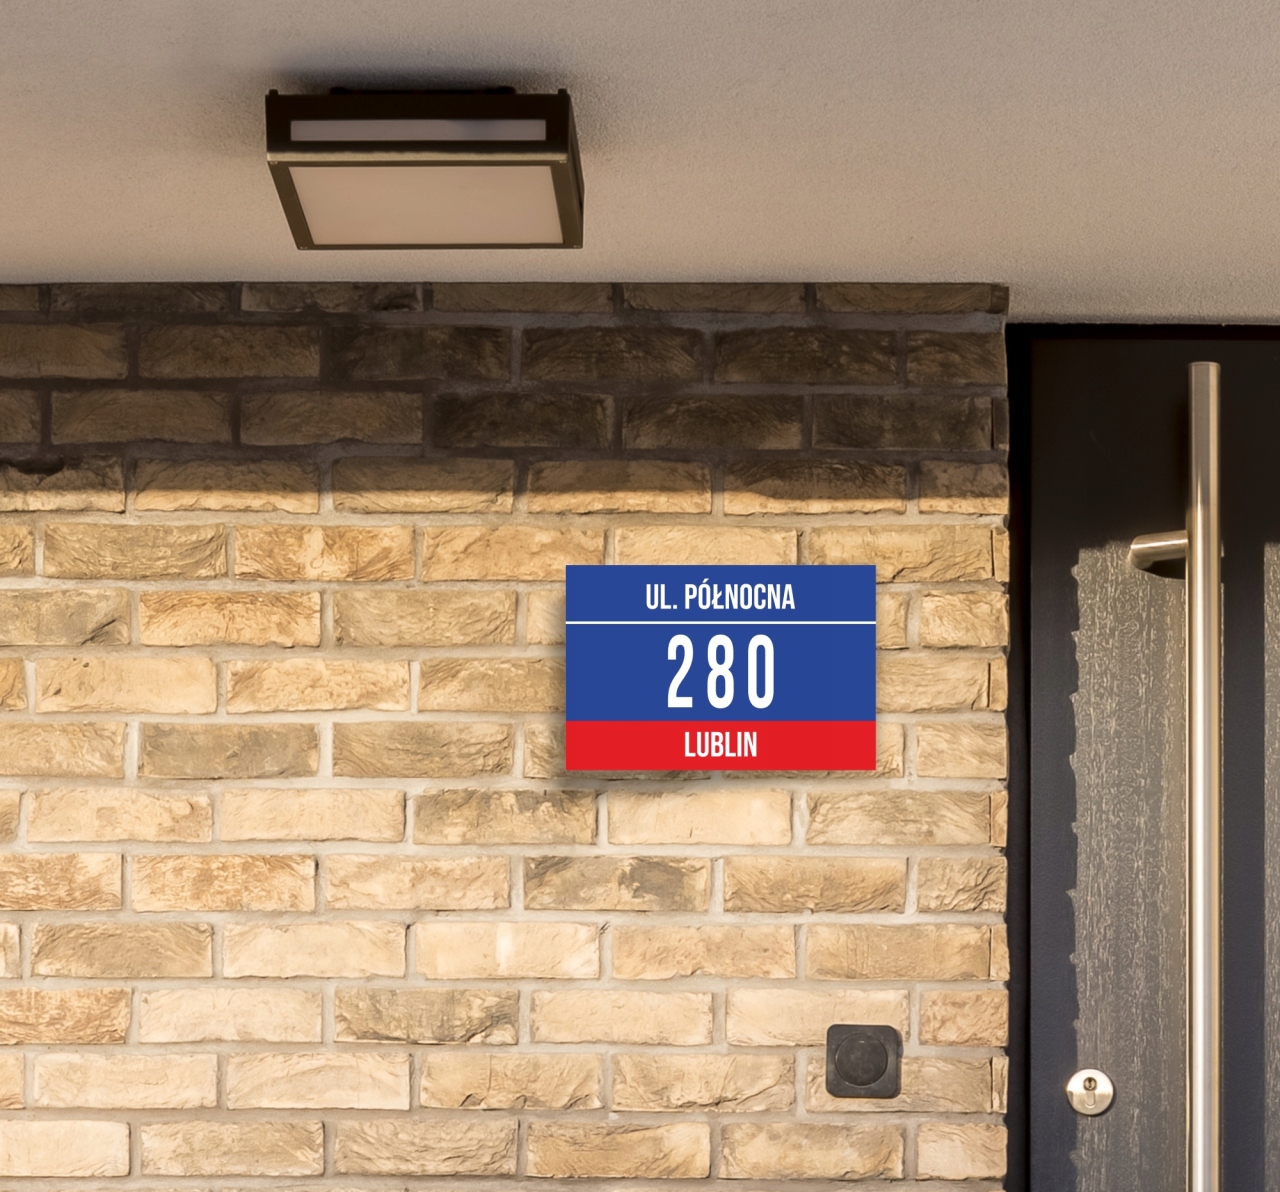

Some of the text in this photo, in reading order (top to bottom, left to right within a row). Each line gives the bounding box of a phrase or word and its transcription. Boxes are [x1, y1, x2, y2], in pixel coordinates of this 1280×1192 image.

[646, 578, 795, 609] UL. PÓŁNOCNA
[667, 634, 775, 709] 280
[685, 731, 757, 757] LUBLIN
